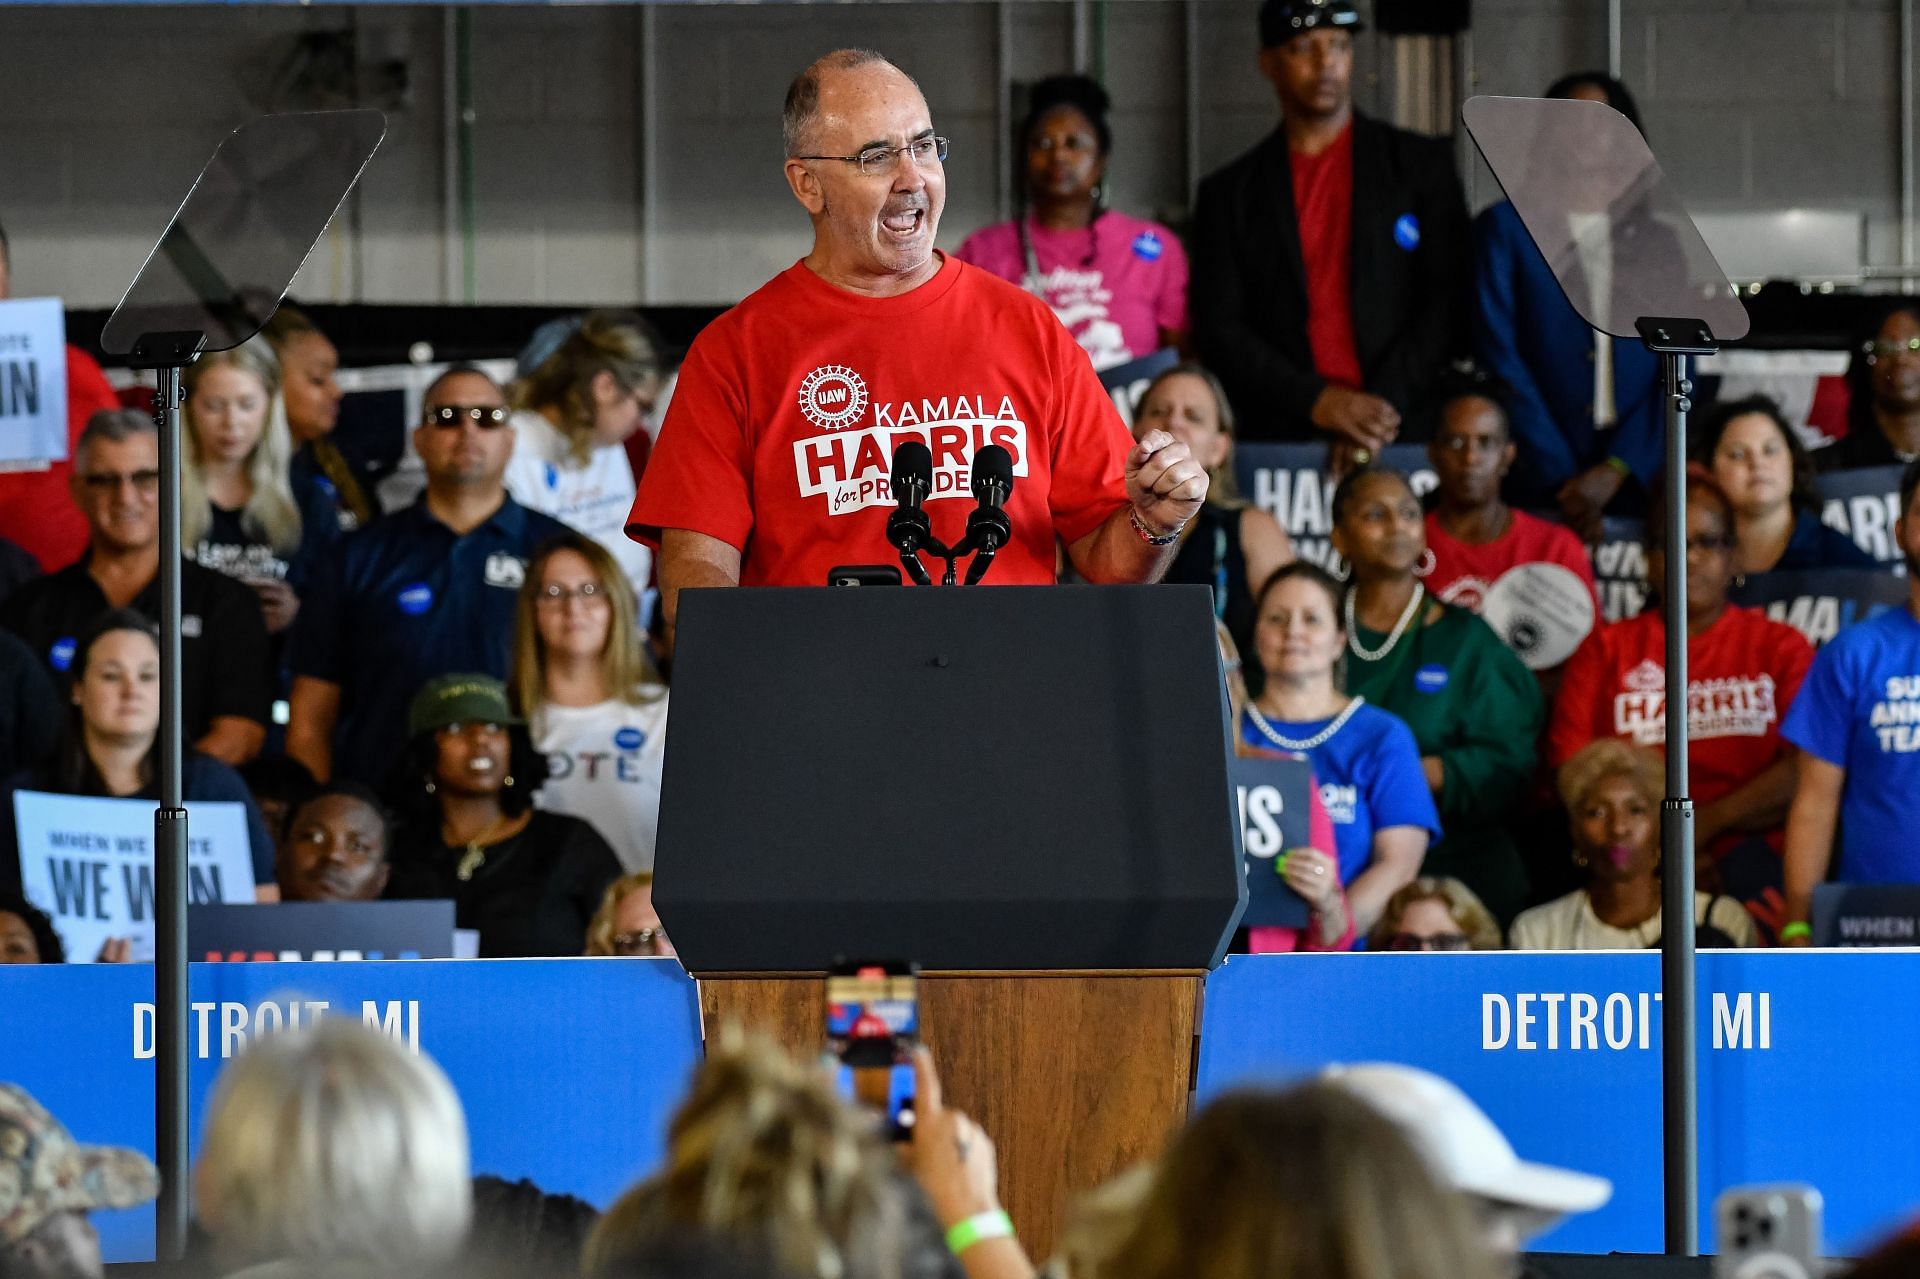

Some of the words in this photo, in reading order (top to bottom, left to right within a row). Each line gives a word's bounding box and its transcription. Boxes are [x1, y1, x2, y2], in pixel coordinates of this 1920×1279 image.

[818, 388, 847, 405] UAW
[873, 395, 1018, 427] KAMALA
[834, 486, 859, 511] for
[116, 836, 147, 852] WE
[48, 856, 110, 920] WE
[121, 864, 224, 921] WN
[1712, 993, 1771, 1050] MI
